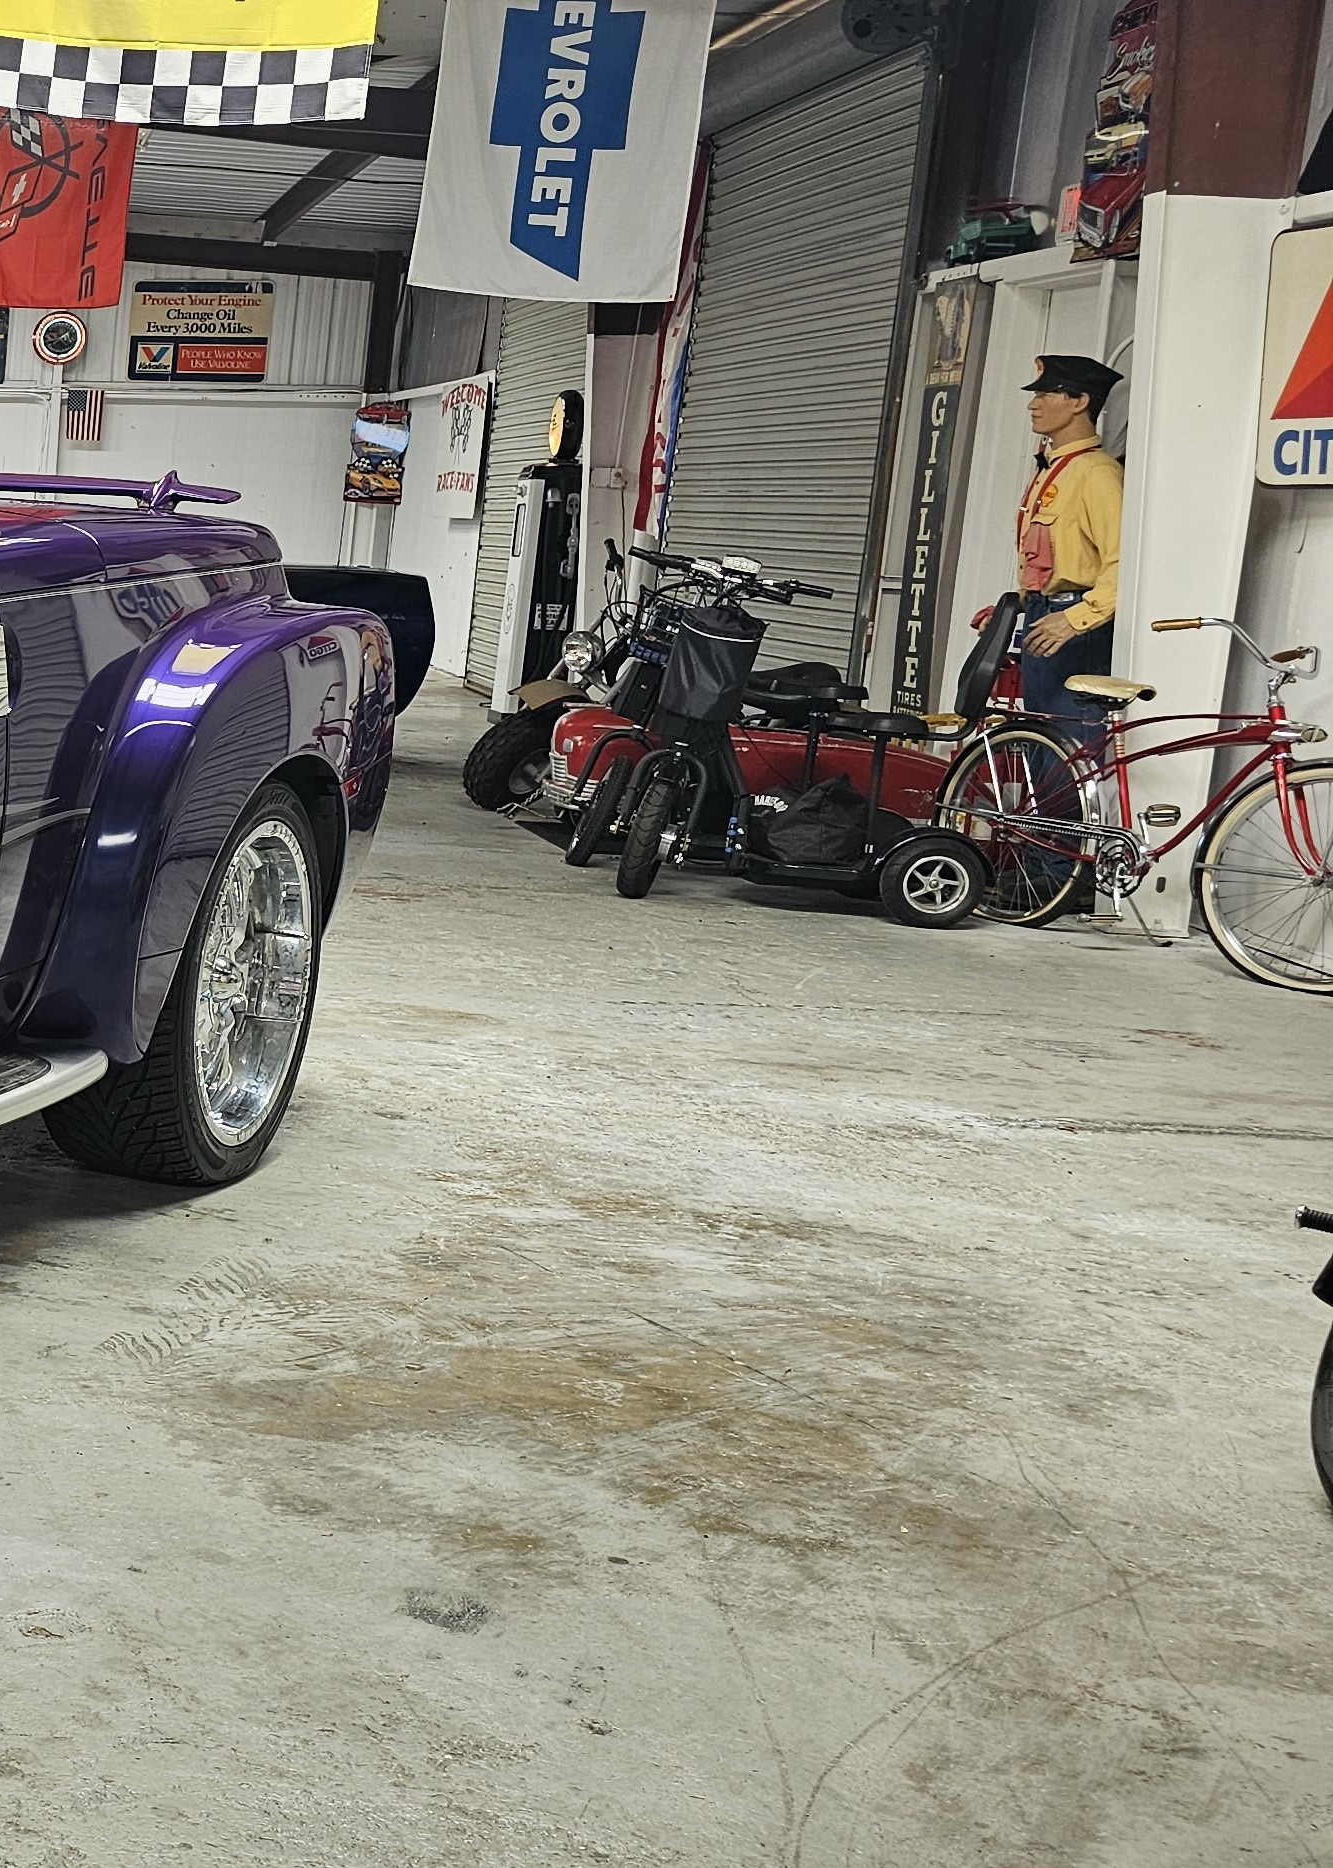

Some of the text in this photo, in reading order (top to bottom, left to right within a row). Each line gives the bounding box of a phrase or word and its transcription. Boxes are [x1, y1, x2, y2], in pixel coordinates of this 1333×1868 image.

[528, 1, 596, 237] EVROLET
[142, 294, 262, 308] Protect Your Engine
[166, 308, 236, 322] Change Oil
[146, 322, 253, 335] Every 3,000 Miles
[181, 349, 263, 359] PEOPLE WHO KNOW
[137, 362, 171, 370] Valvoline
[441, 384, 487, 417] WELCOME
[1274, 429, 1333, 476] CIT
[903, 391, 948, 688] GILLETTE
[896, 690, 922, 707] TIRES
